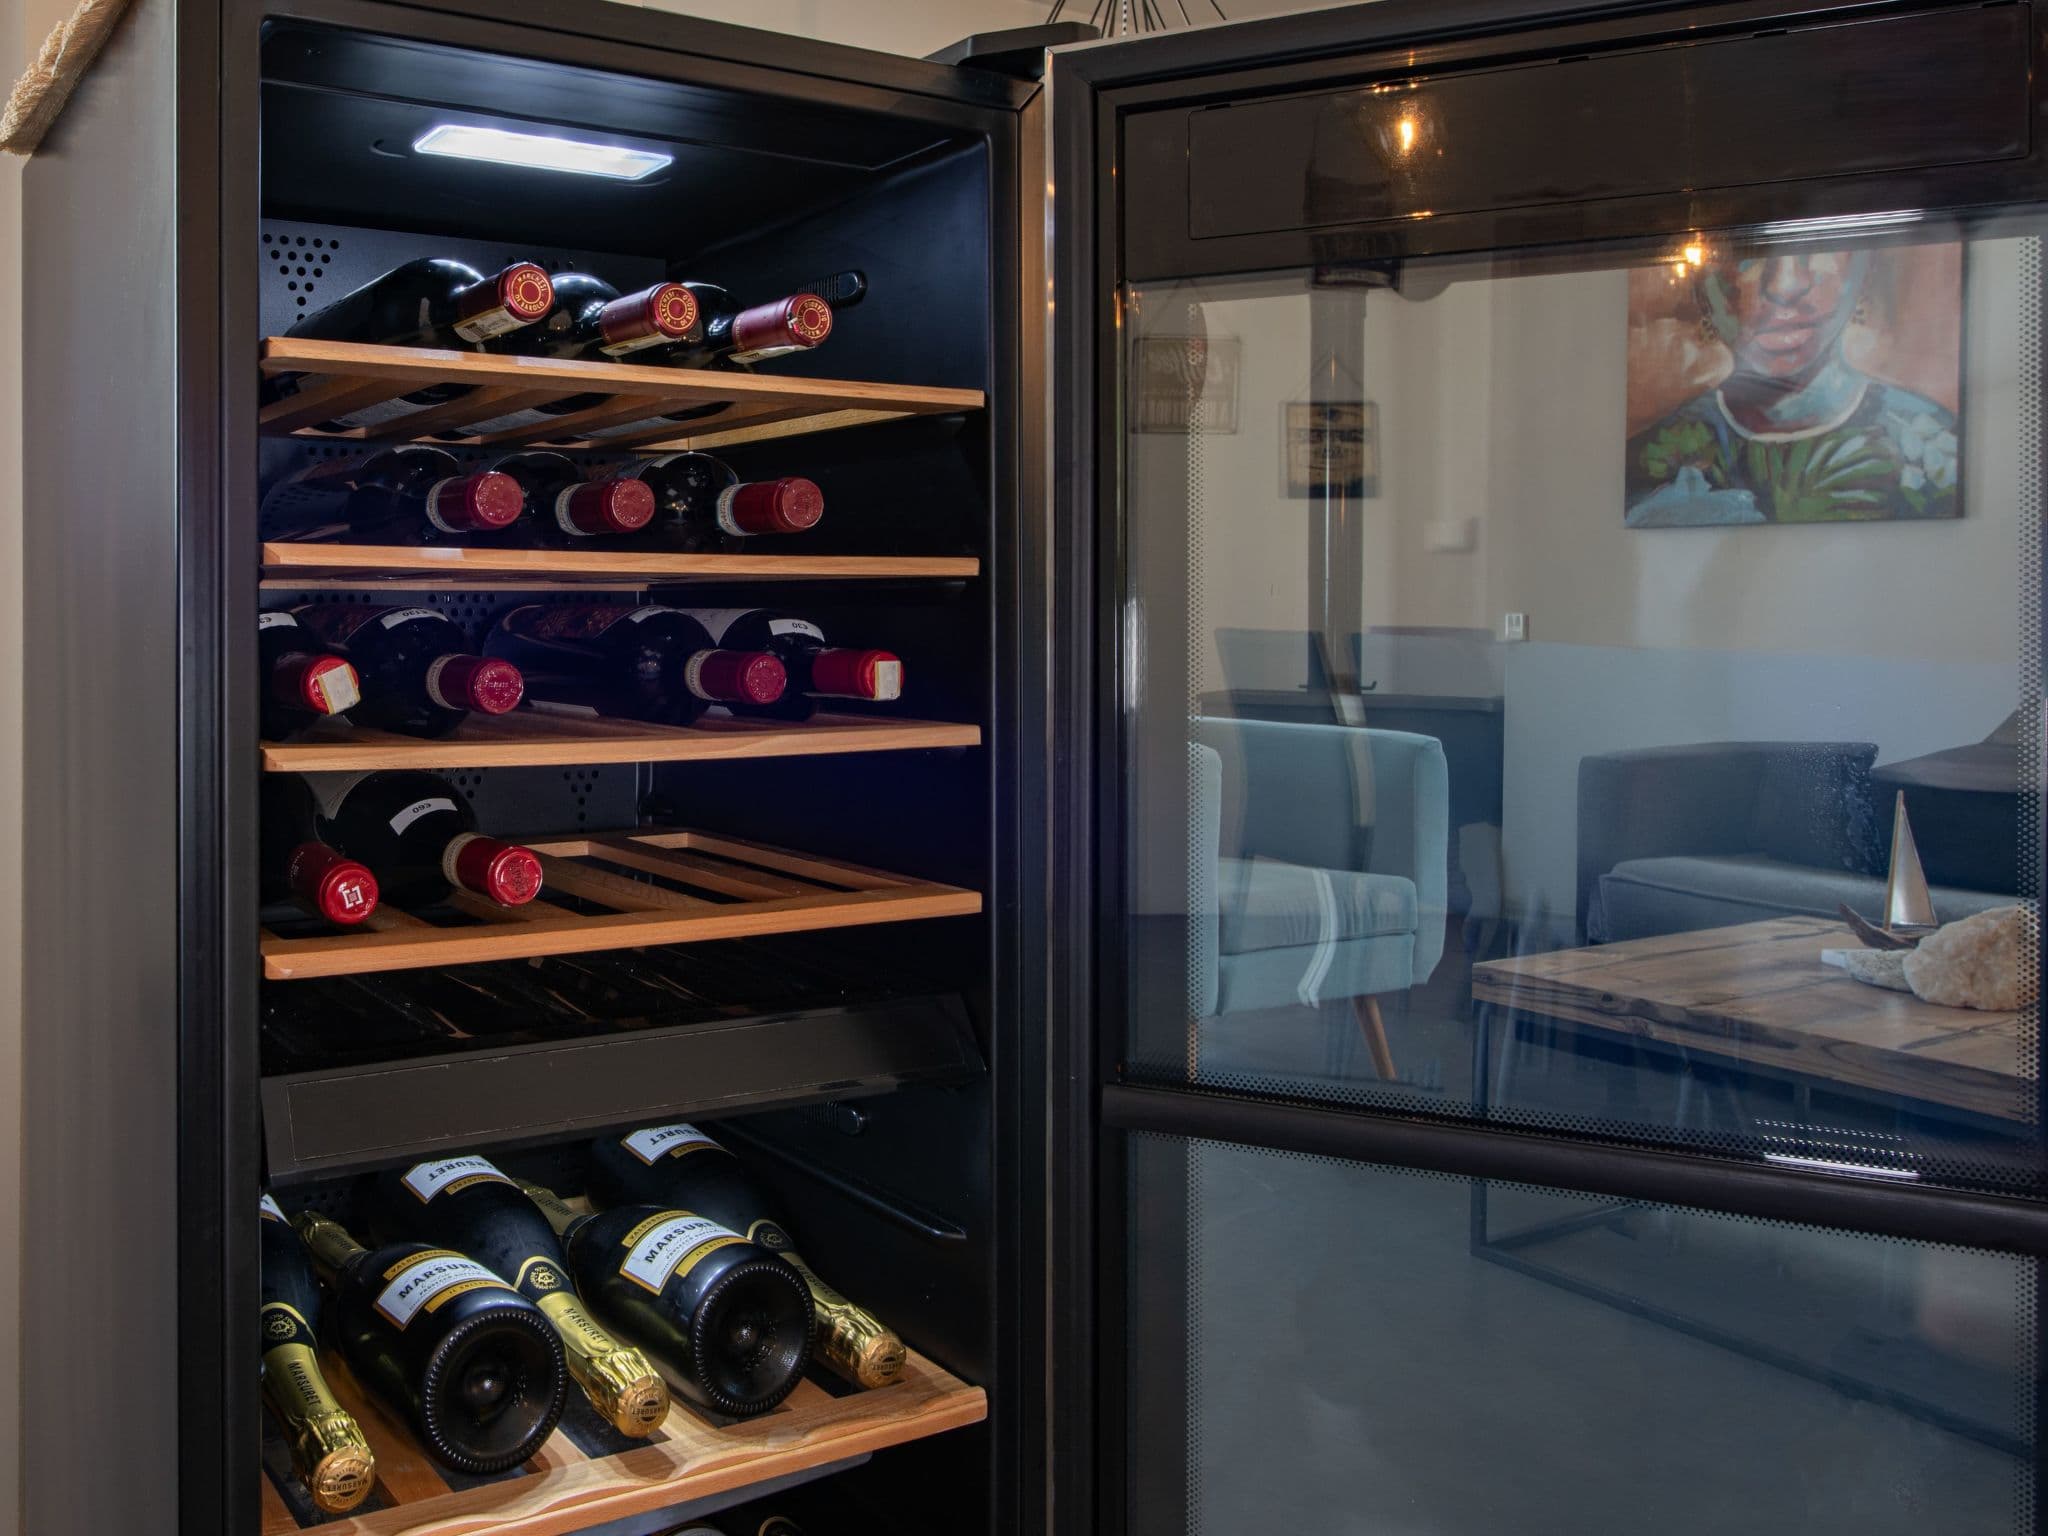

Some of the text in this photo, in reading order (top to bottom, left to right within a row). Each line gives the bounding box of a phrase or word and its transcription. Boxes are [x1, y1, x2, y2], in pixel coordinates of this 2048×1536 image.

[516, 271, 549, 293] MARCHESI
[520, 300, 546, 313] BAROLO
[791, 621, 809, 631] €30
[411, 802, 432, 814] €60
[563, 1307, 609, 1344] MARSURET
[287, 1360, 322, 1407] MARSURET
